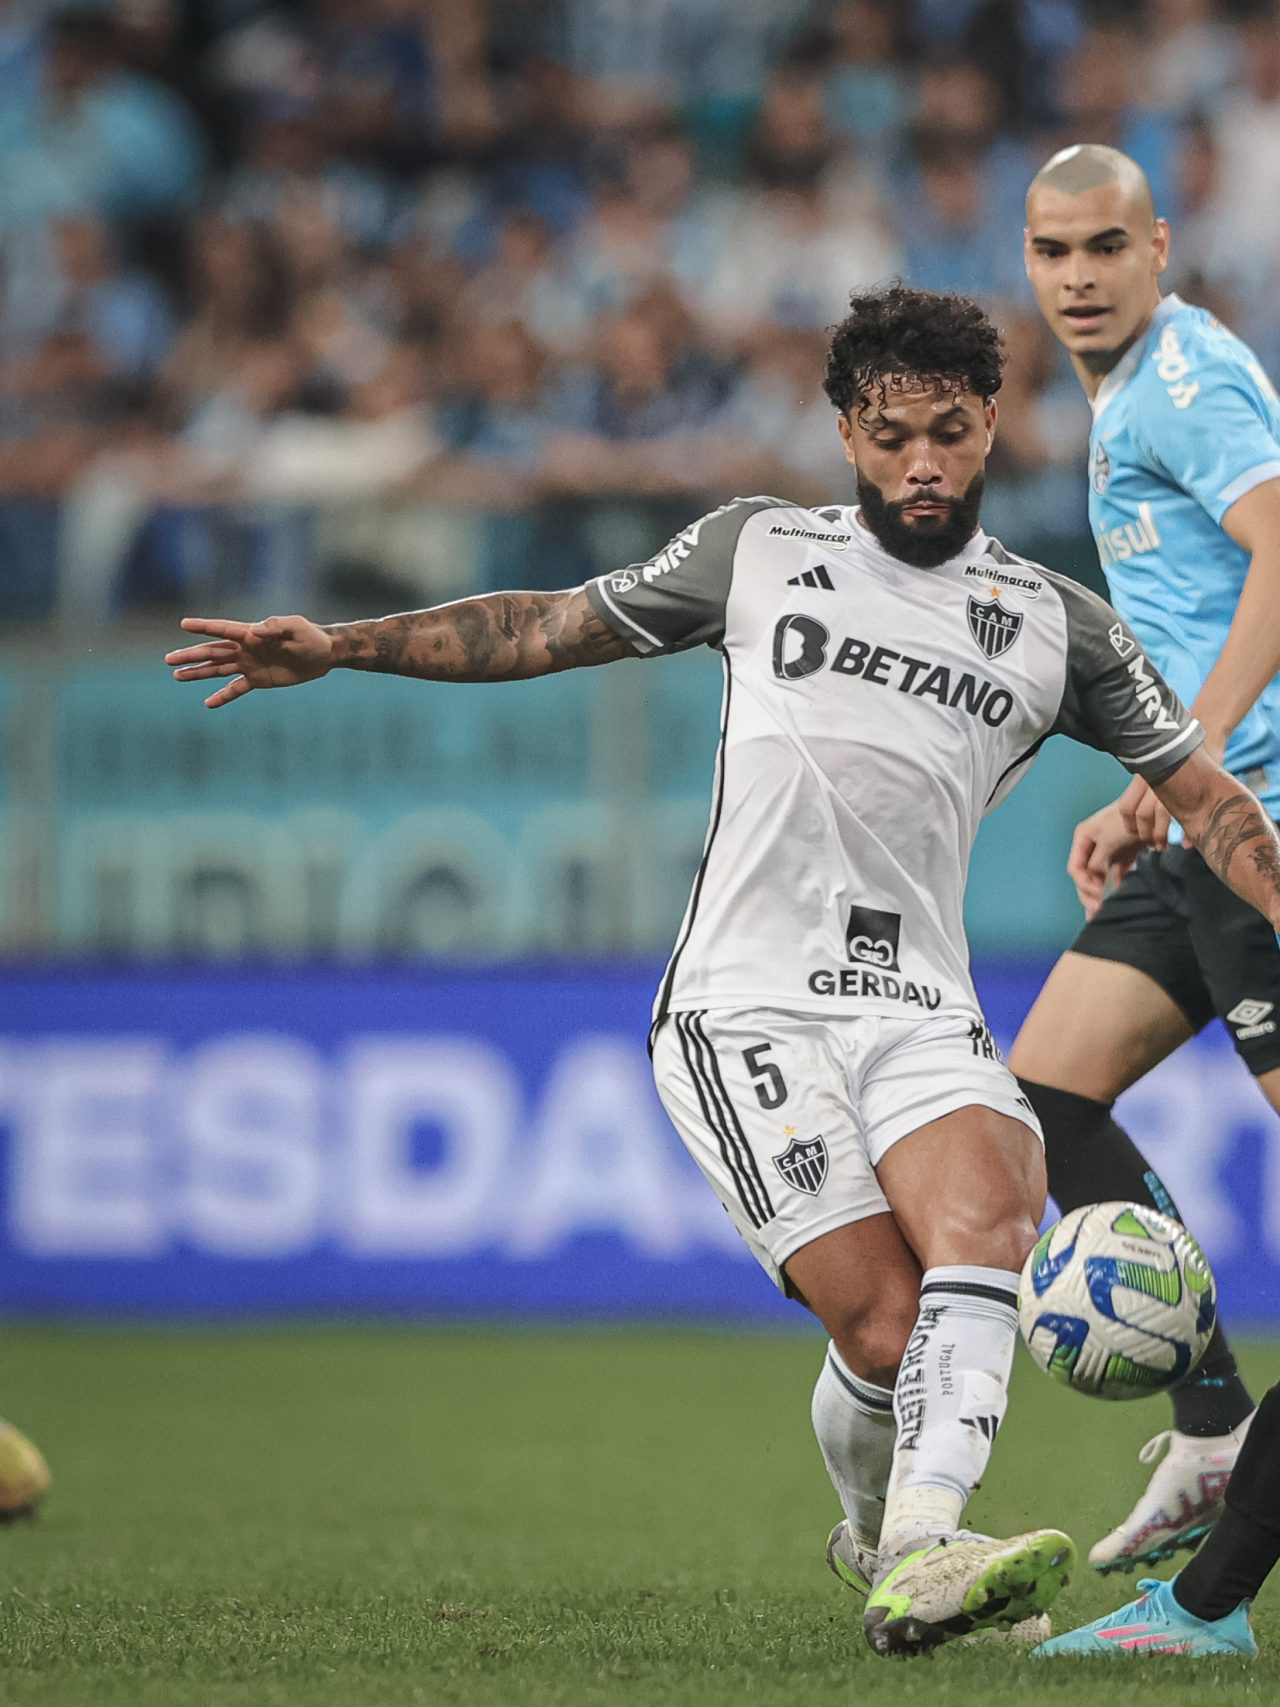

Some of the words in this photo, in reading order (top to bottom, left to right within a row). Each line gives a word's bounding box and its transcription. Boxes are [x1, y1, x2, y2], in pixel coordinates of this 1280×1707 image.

[642, 524, 701, 583] MRV
[769, 526, 852, 542] Multimarcas
[964, 565, 1042, 591] Multimarcas
[976, 607, 1013, 627] CAM
[830, 637, 1014, 728] BETANO
[1127, 655, 1180, 729] MRV
[808, 969, 942, 1011] GERDAU
[742, 1043, 788, 1111] 5
[782, 1146, 818, 1167] CAM
[939, 1343, 956, 1396] PORTUGAL
